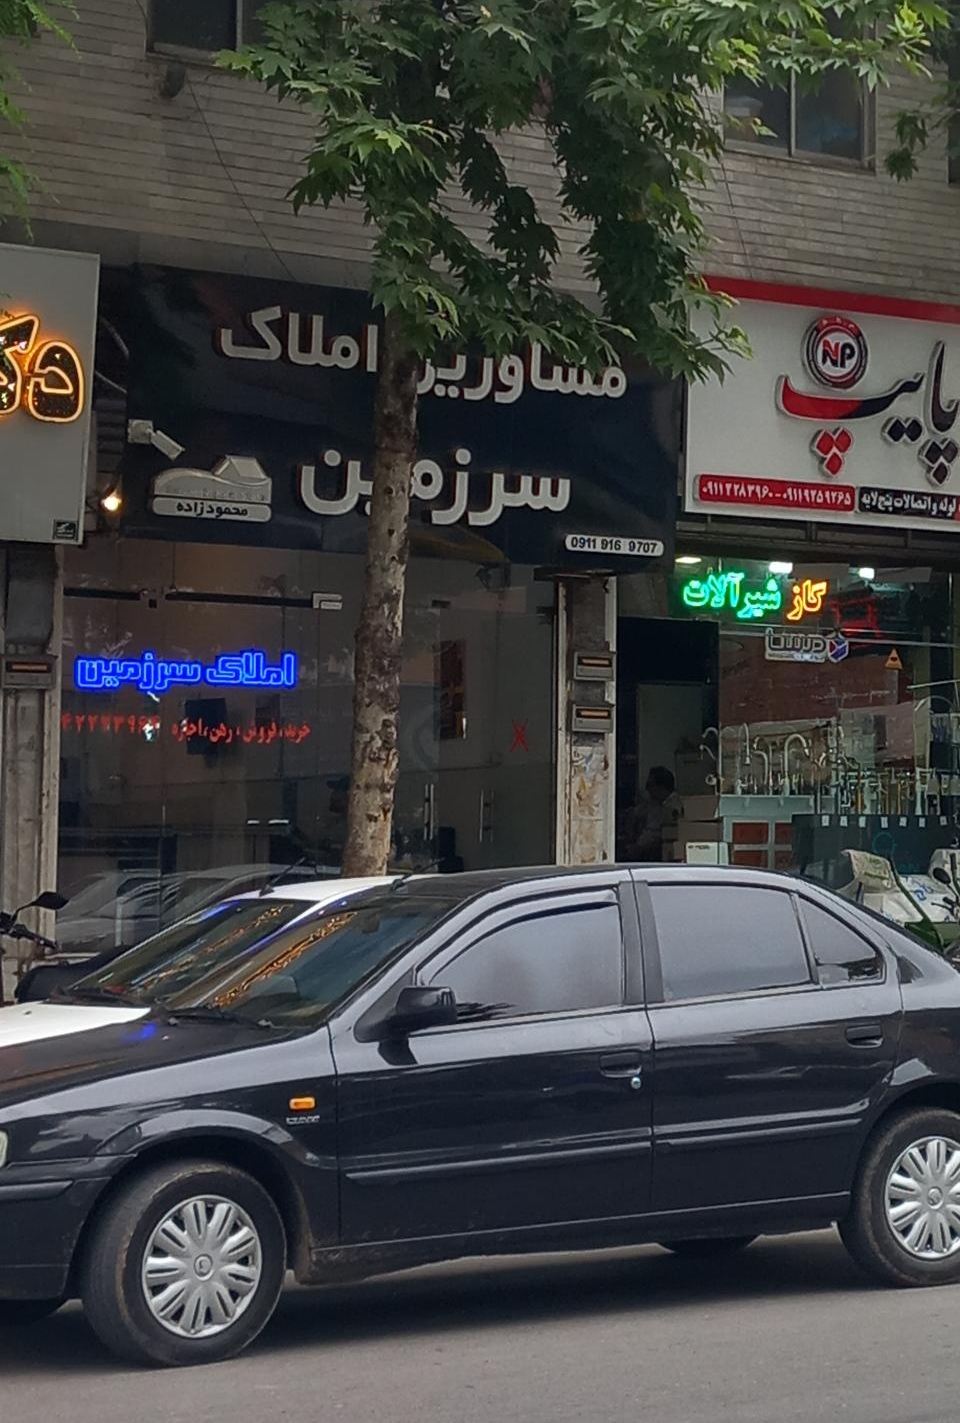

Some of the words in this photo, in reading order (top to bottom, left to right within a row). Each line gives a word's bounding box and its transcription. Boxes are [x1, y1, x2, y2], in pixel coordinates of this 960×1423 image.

[219, 305, 380, 374] املاک
[822, 337, 856, 369] NP
[570, 536, 597, 549] 0911
[600, 538, 622, 551] 916
[628, 540, 658, 554] 9707
[785, 579, 828, 621] گاز
[75, 650, 203, 691] سرزمین
[205, 650, 297, 687] املاک
